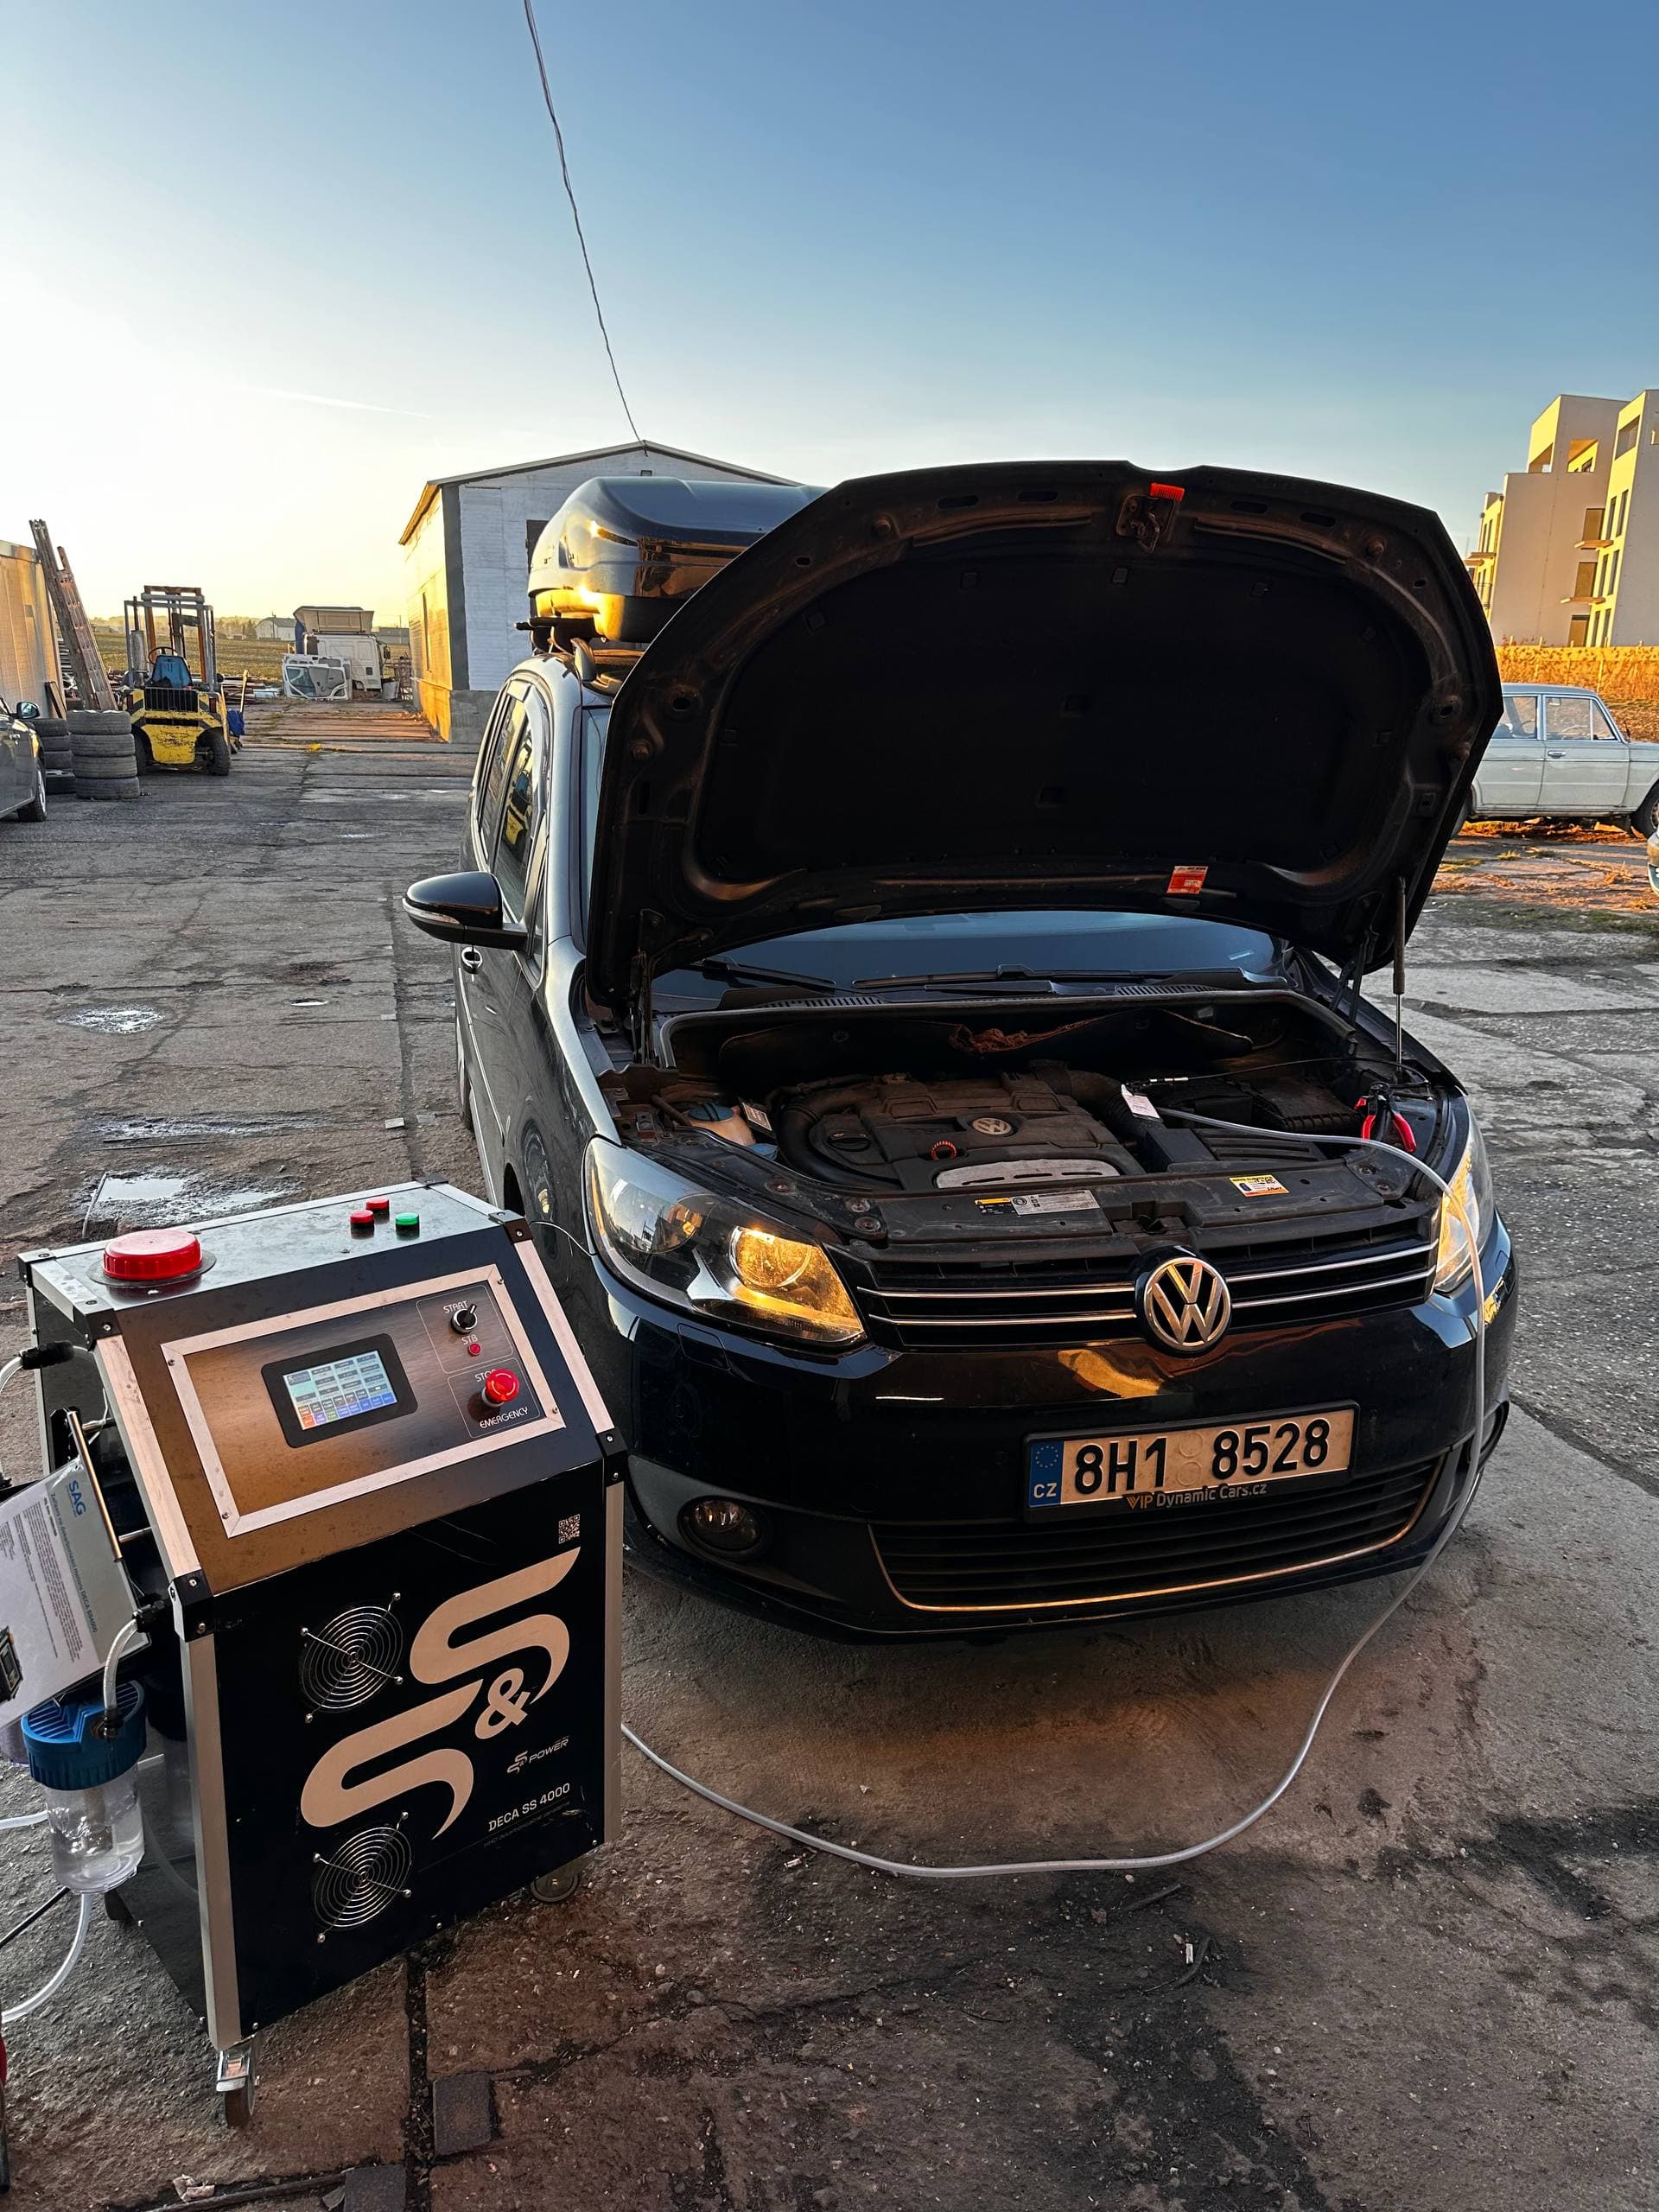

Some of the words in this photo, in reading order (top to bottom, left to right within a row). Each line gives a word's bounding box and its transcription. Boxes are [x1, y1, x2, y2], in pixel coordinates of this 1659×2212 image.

[443, 1300, 468, 1314] START
[1144, 1256, 1231, 1352] VW
[480, 1406, 528, 1429] EMERGENCY
[1074, 1437, 1167, 1495] 8H1
[1211, 1417, 1331, 1481] 8528
[68, 1479, 86, 1516] SAG
[1033, 1481, 1058, 1499] CZ
[1126, 1494, 1154, 1510] VIP
[1156, 1489, 1216, 1508] Dynamic
[1219, 1484, 1268, 1499] Cars.cz
[529, 1737, 569, 1764] POWER
[488, 1808, 519, 1832] DECA
[522, 1799, 537, 1814] SS
[539, 1783, 570, 1805] 4000
